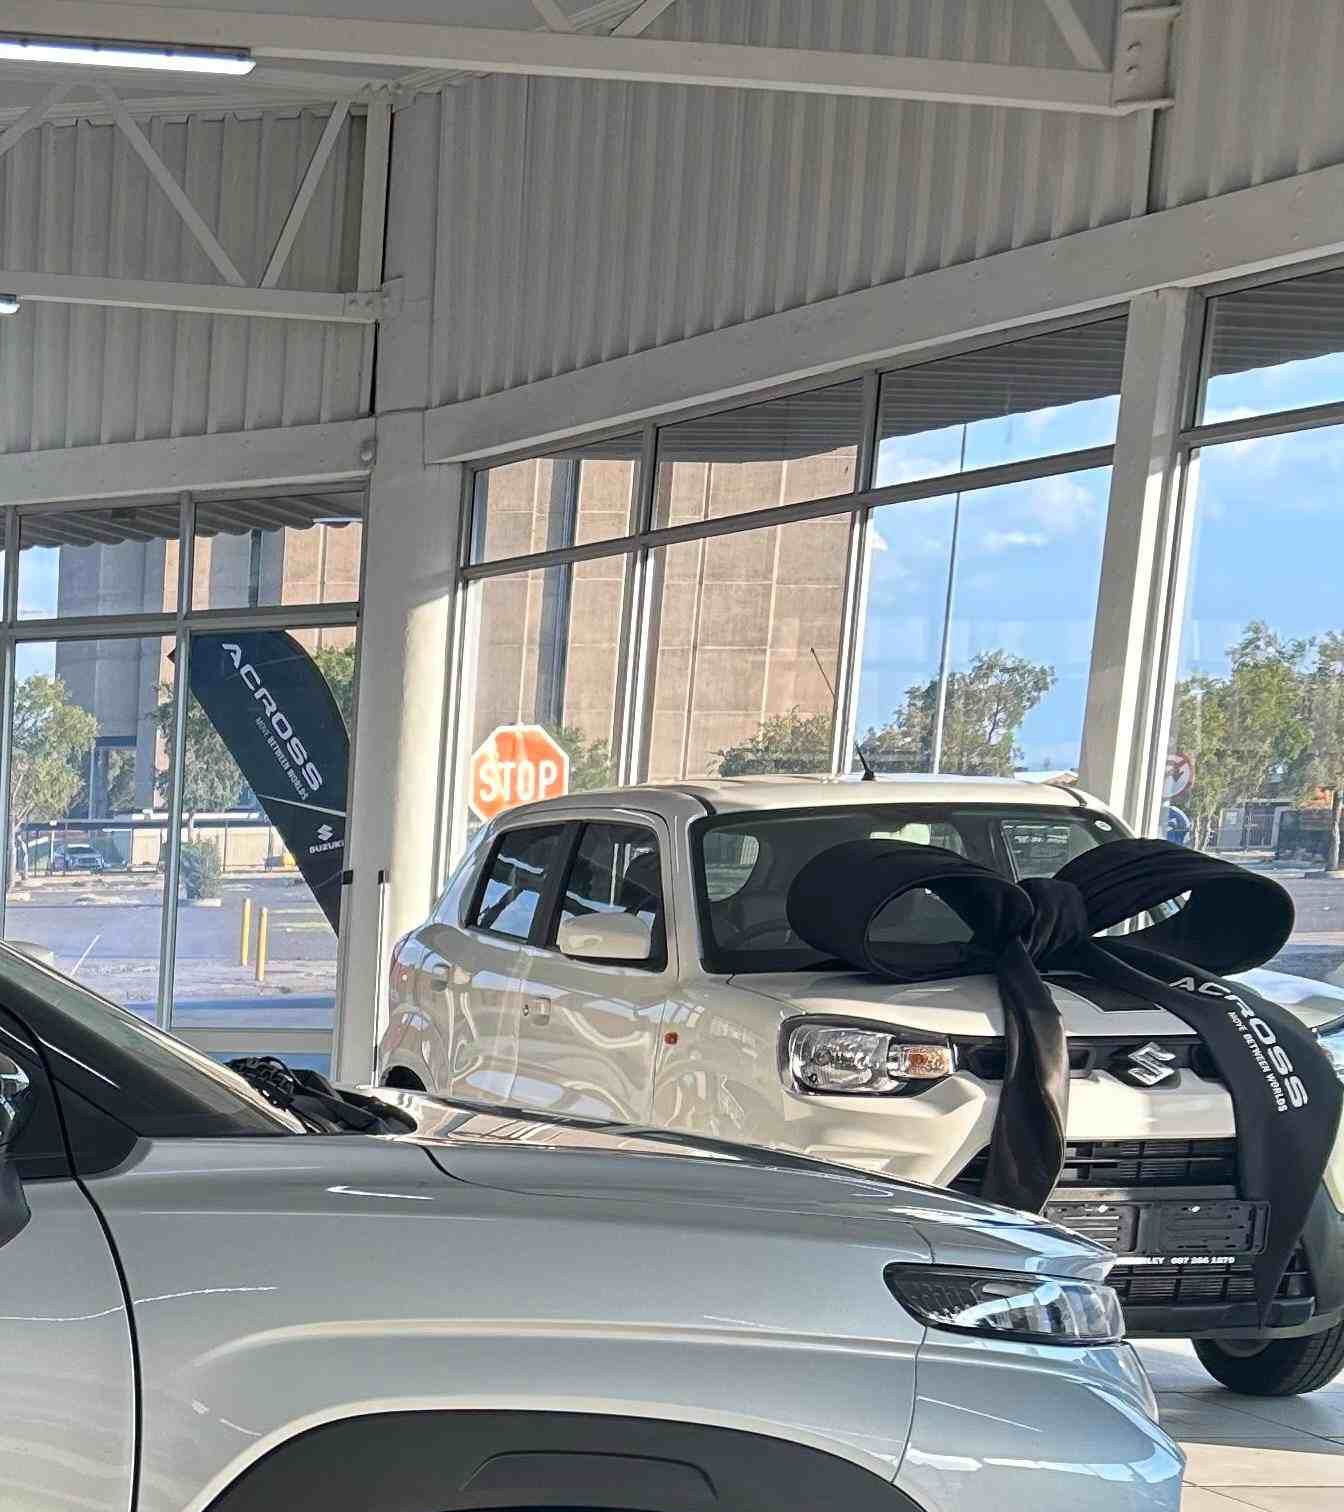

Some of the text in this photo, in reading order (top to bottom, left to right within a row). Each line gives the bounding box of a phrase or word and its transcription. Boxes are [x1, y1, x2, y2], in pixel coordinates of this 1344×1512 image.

[221, 642, 323, 792] ACROSS
[479, 759, 557, 803] STOP
[309, 840, 345, 854] SUZUKI
[1169, 976, 1309, 1108] ACROSS
[1243, 1033, 1272, 1073] BETWEEN
[1265, 1073, 1288, 1112] WORLDS
